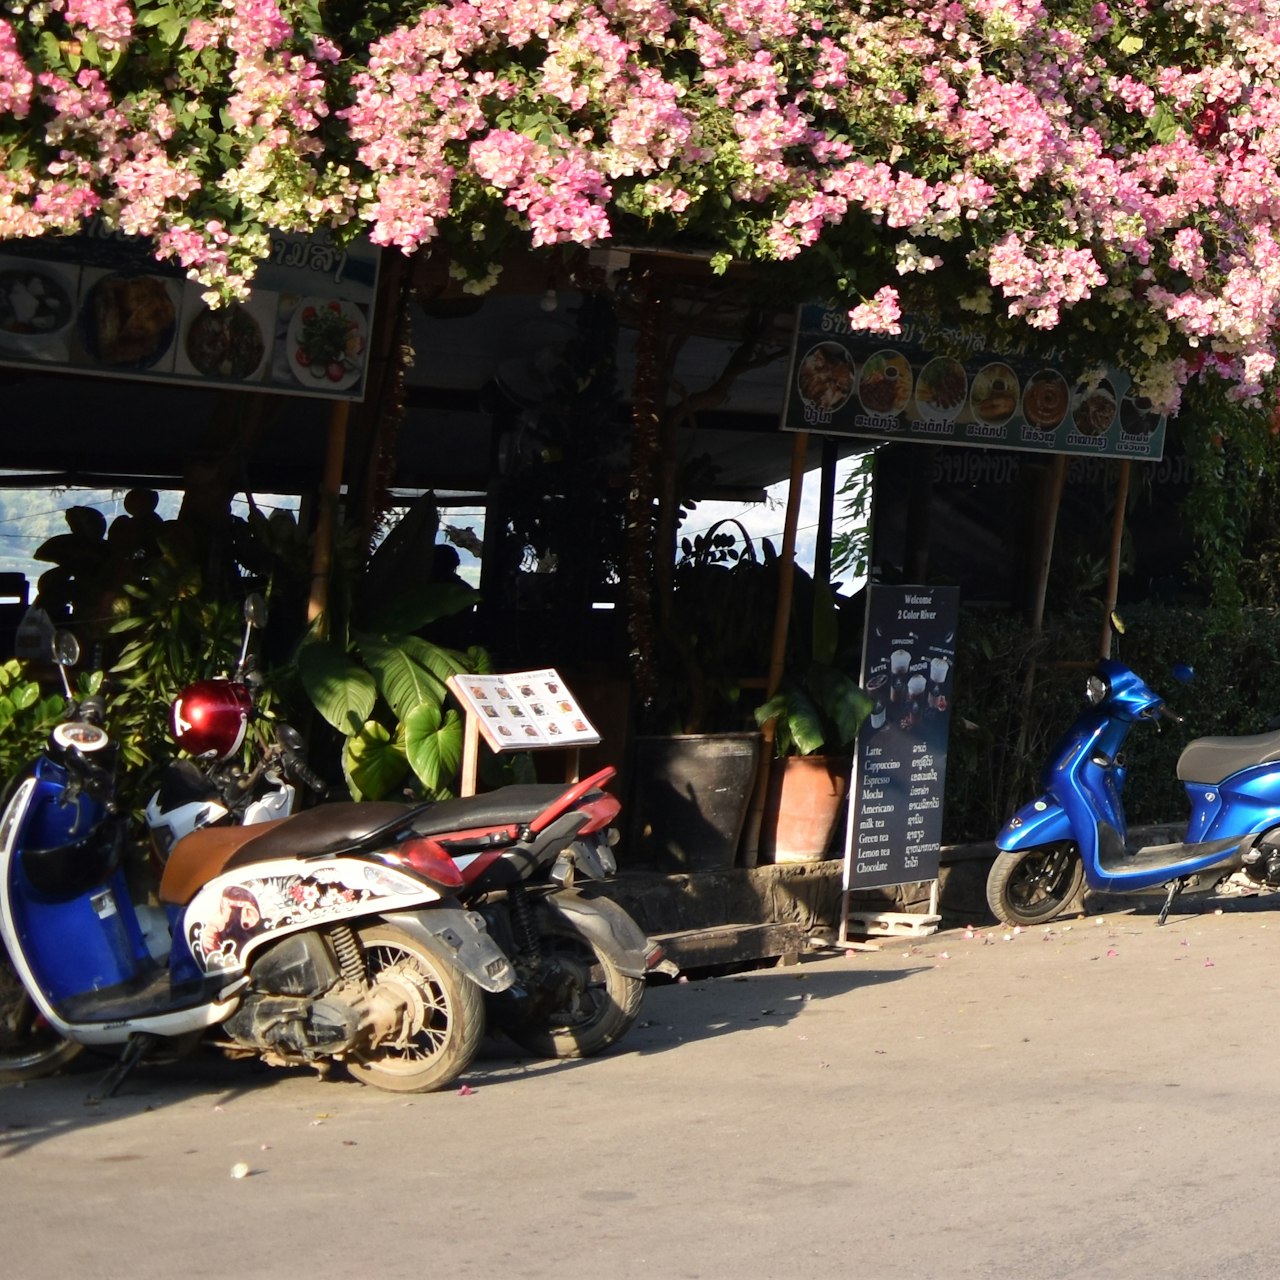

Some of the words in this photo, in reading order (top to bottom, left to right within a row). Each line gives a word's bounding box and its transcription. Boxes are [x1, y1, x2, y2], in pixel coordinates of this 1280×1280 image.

[905, 594, 932, 604] Welcome
[897, 610, 902, 619] 2
[903, 609, 919, 619] Color
[920, 610, 936, 619] River
[866, 746, 882, 756] Latte
[864, 759, 900, 773] Cappuccino
[863, 775, 890, 787] Espresso
[862, 789, 884, 800] Mocha
[861, 803, 895, 814] Americano
[860, 818, 874, 829] milk
[875, 819, 885, 828] tea
[859, 833, 878, 844] Green
[879, 834, 889, 842] tea
[858, 848, 879, 859] Lemon
[880, 848, 890, 856] tea
[856, 861, 888, 874] Chocolate
